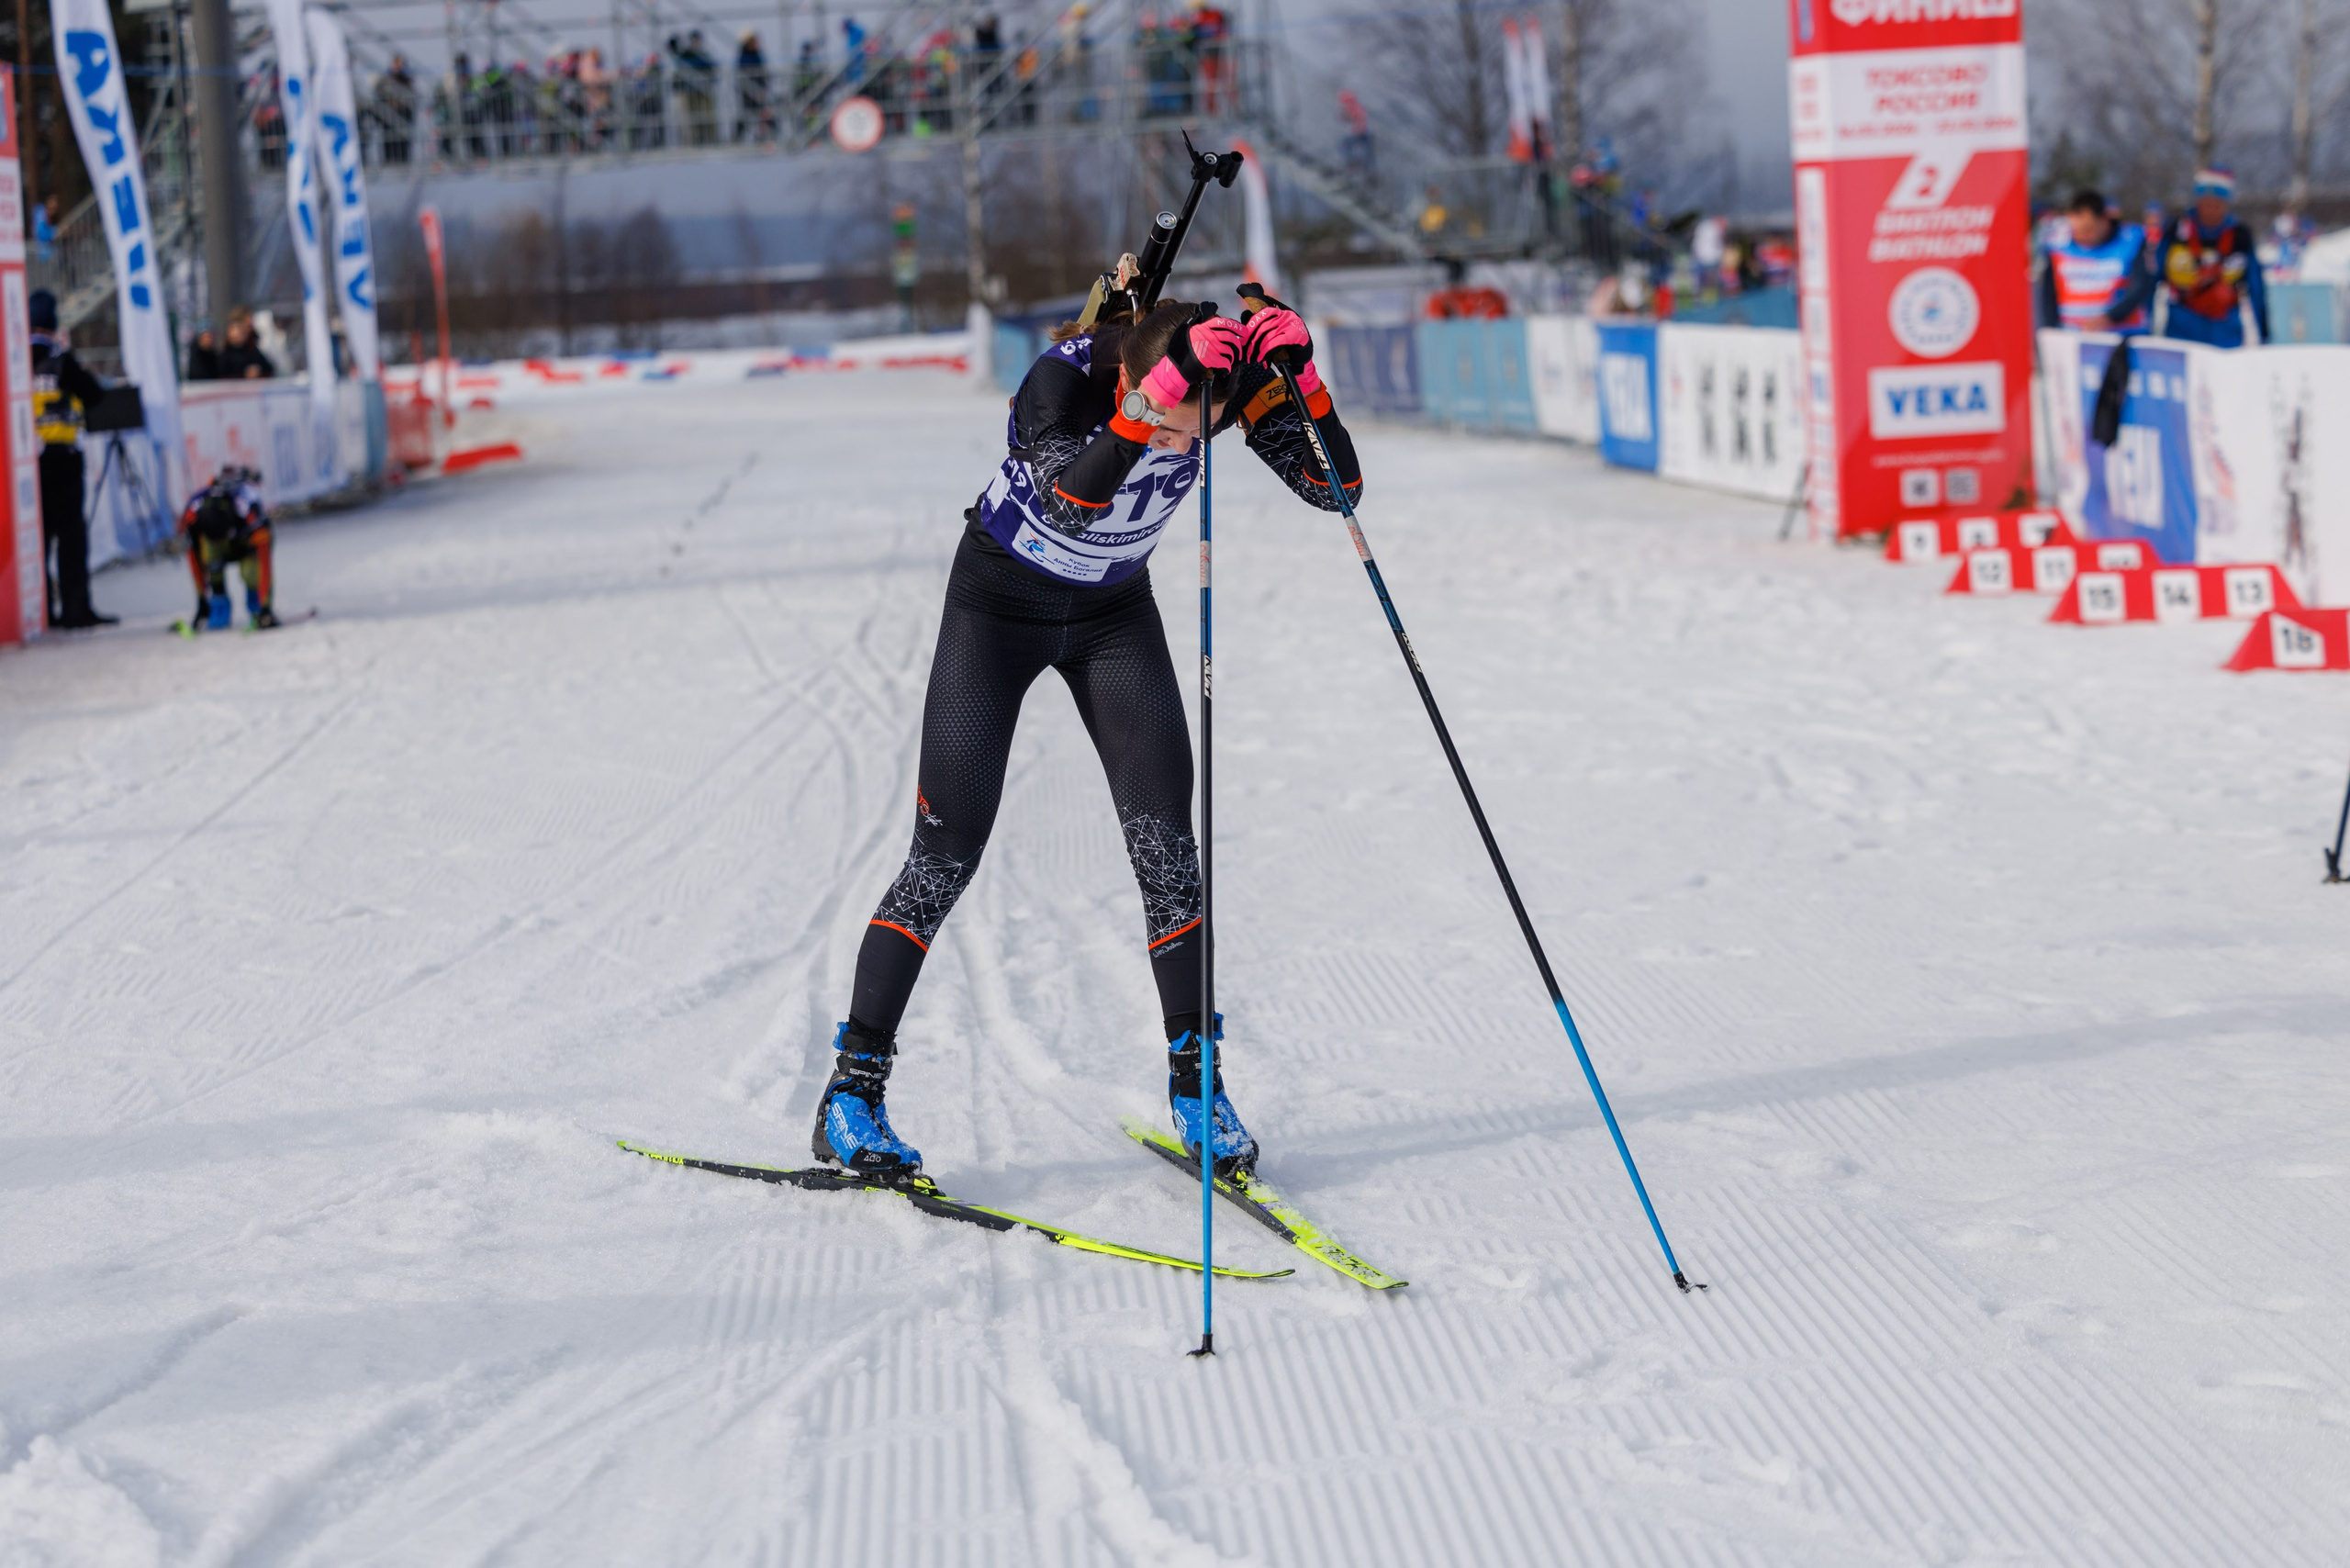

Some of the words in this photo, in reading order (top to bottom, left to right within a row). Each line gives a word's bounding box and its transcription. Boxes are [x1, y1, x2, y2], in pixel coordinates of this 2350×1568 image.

[1248, 310, 1267, 328] OAX
[1886, 383, 1989, 417] VEKA
[1053, 557, 1072, 568] Анны
[1069, 557, 1090, 568] Кубок
[1976, 559, 2002, 583] 12
[2087, 582, 2117, 610] 15
[2163, 581, 2192, 608] 14
[2235, 579, 2264, 605] 13
[849, 1068, 883, 1080] SPINE
[832, 1102, 860, 1149] SPINE
